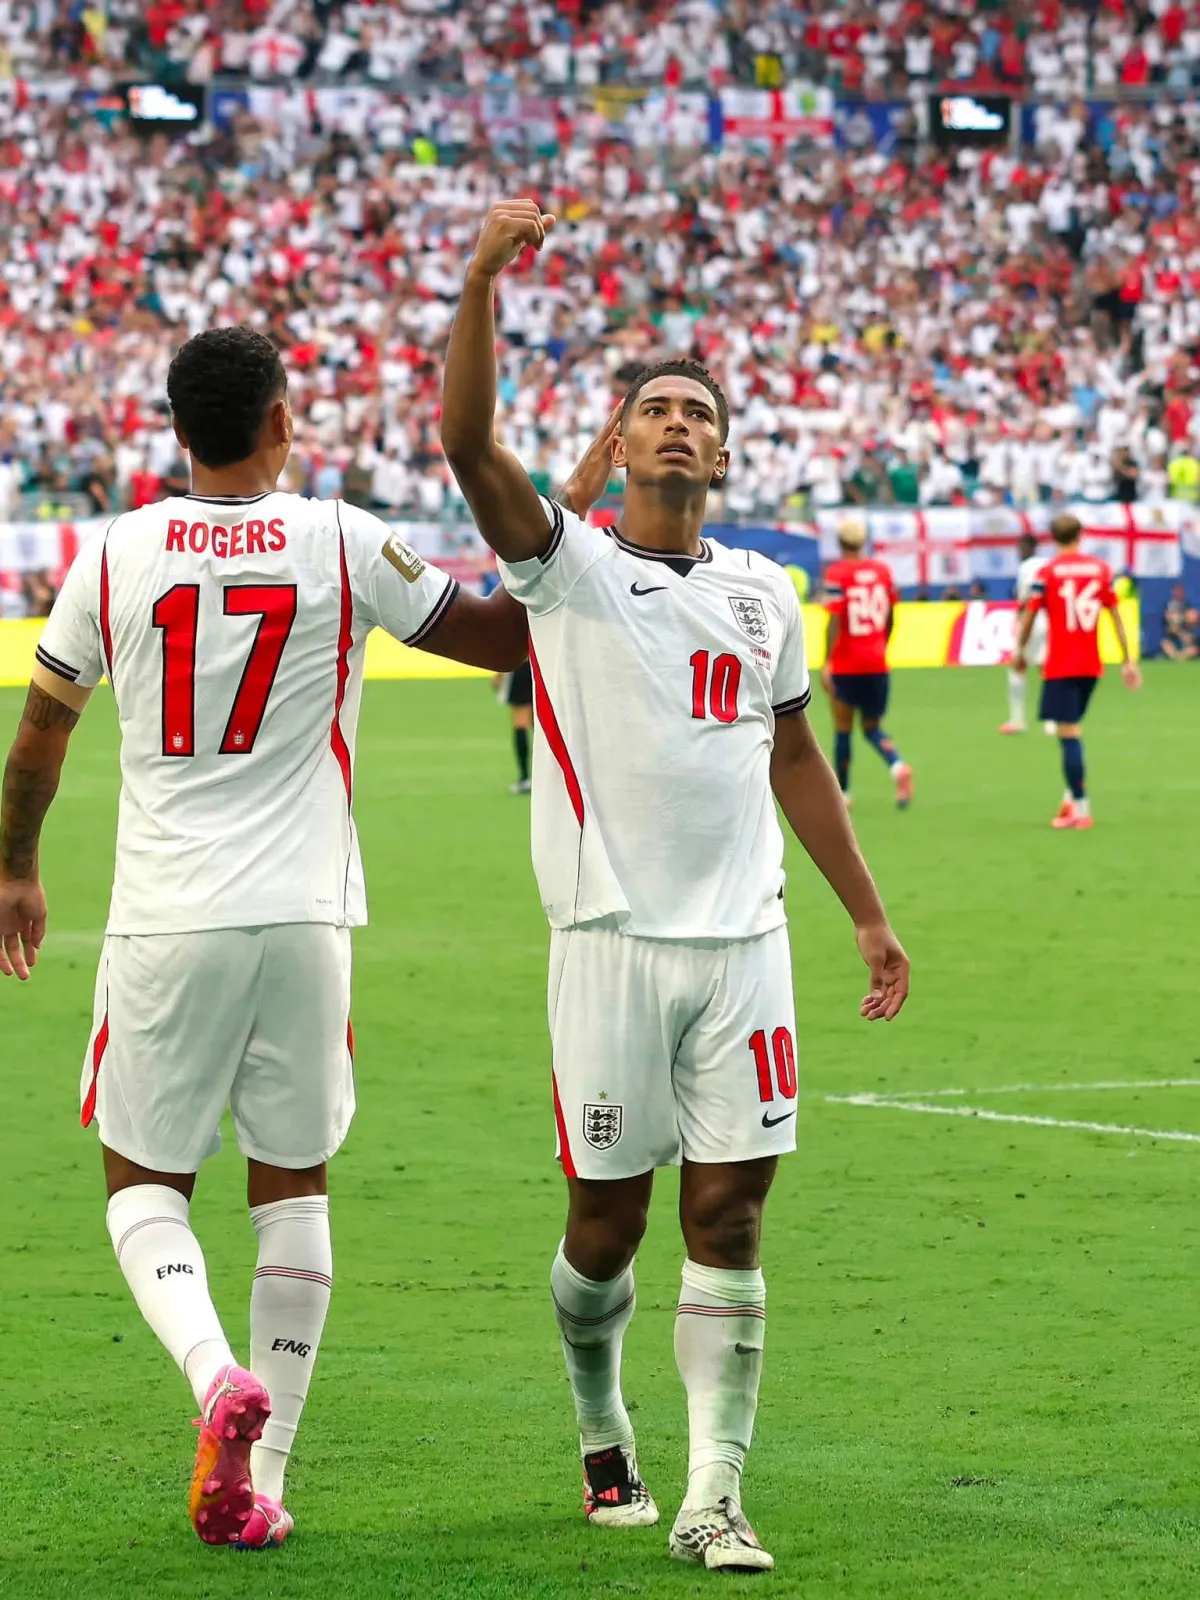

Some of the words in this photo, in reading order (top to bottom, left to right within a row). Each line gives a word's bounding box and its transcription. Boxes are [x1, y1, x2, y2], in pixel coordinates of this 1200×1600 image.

[165, 518, 287, 559] ROGERS
[1057, 578, 1102, 633] 16
[152, 583, 298, 757] 17
[689, 649, 742, 724] 10
[748, 1026, 798, 1103] 10
[155, 1263, 194, 1280] ENG
[271, 1337, 311, 1358] ENG
